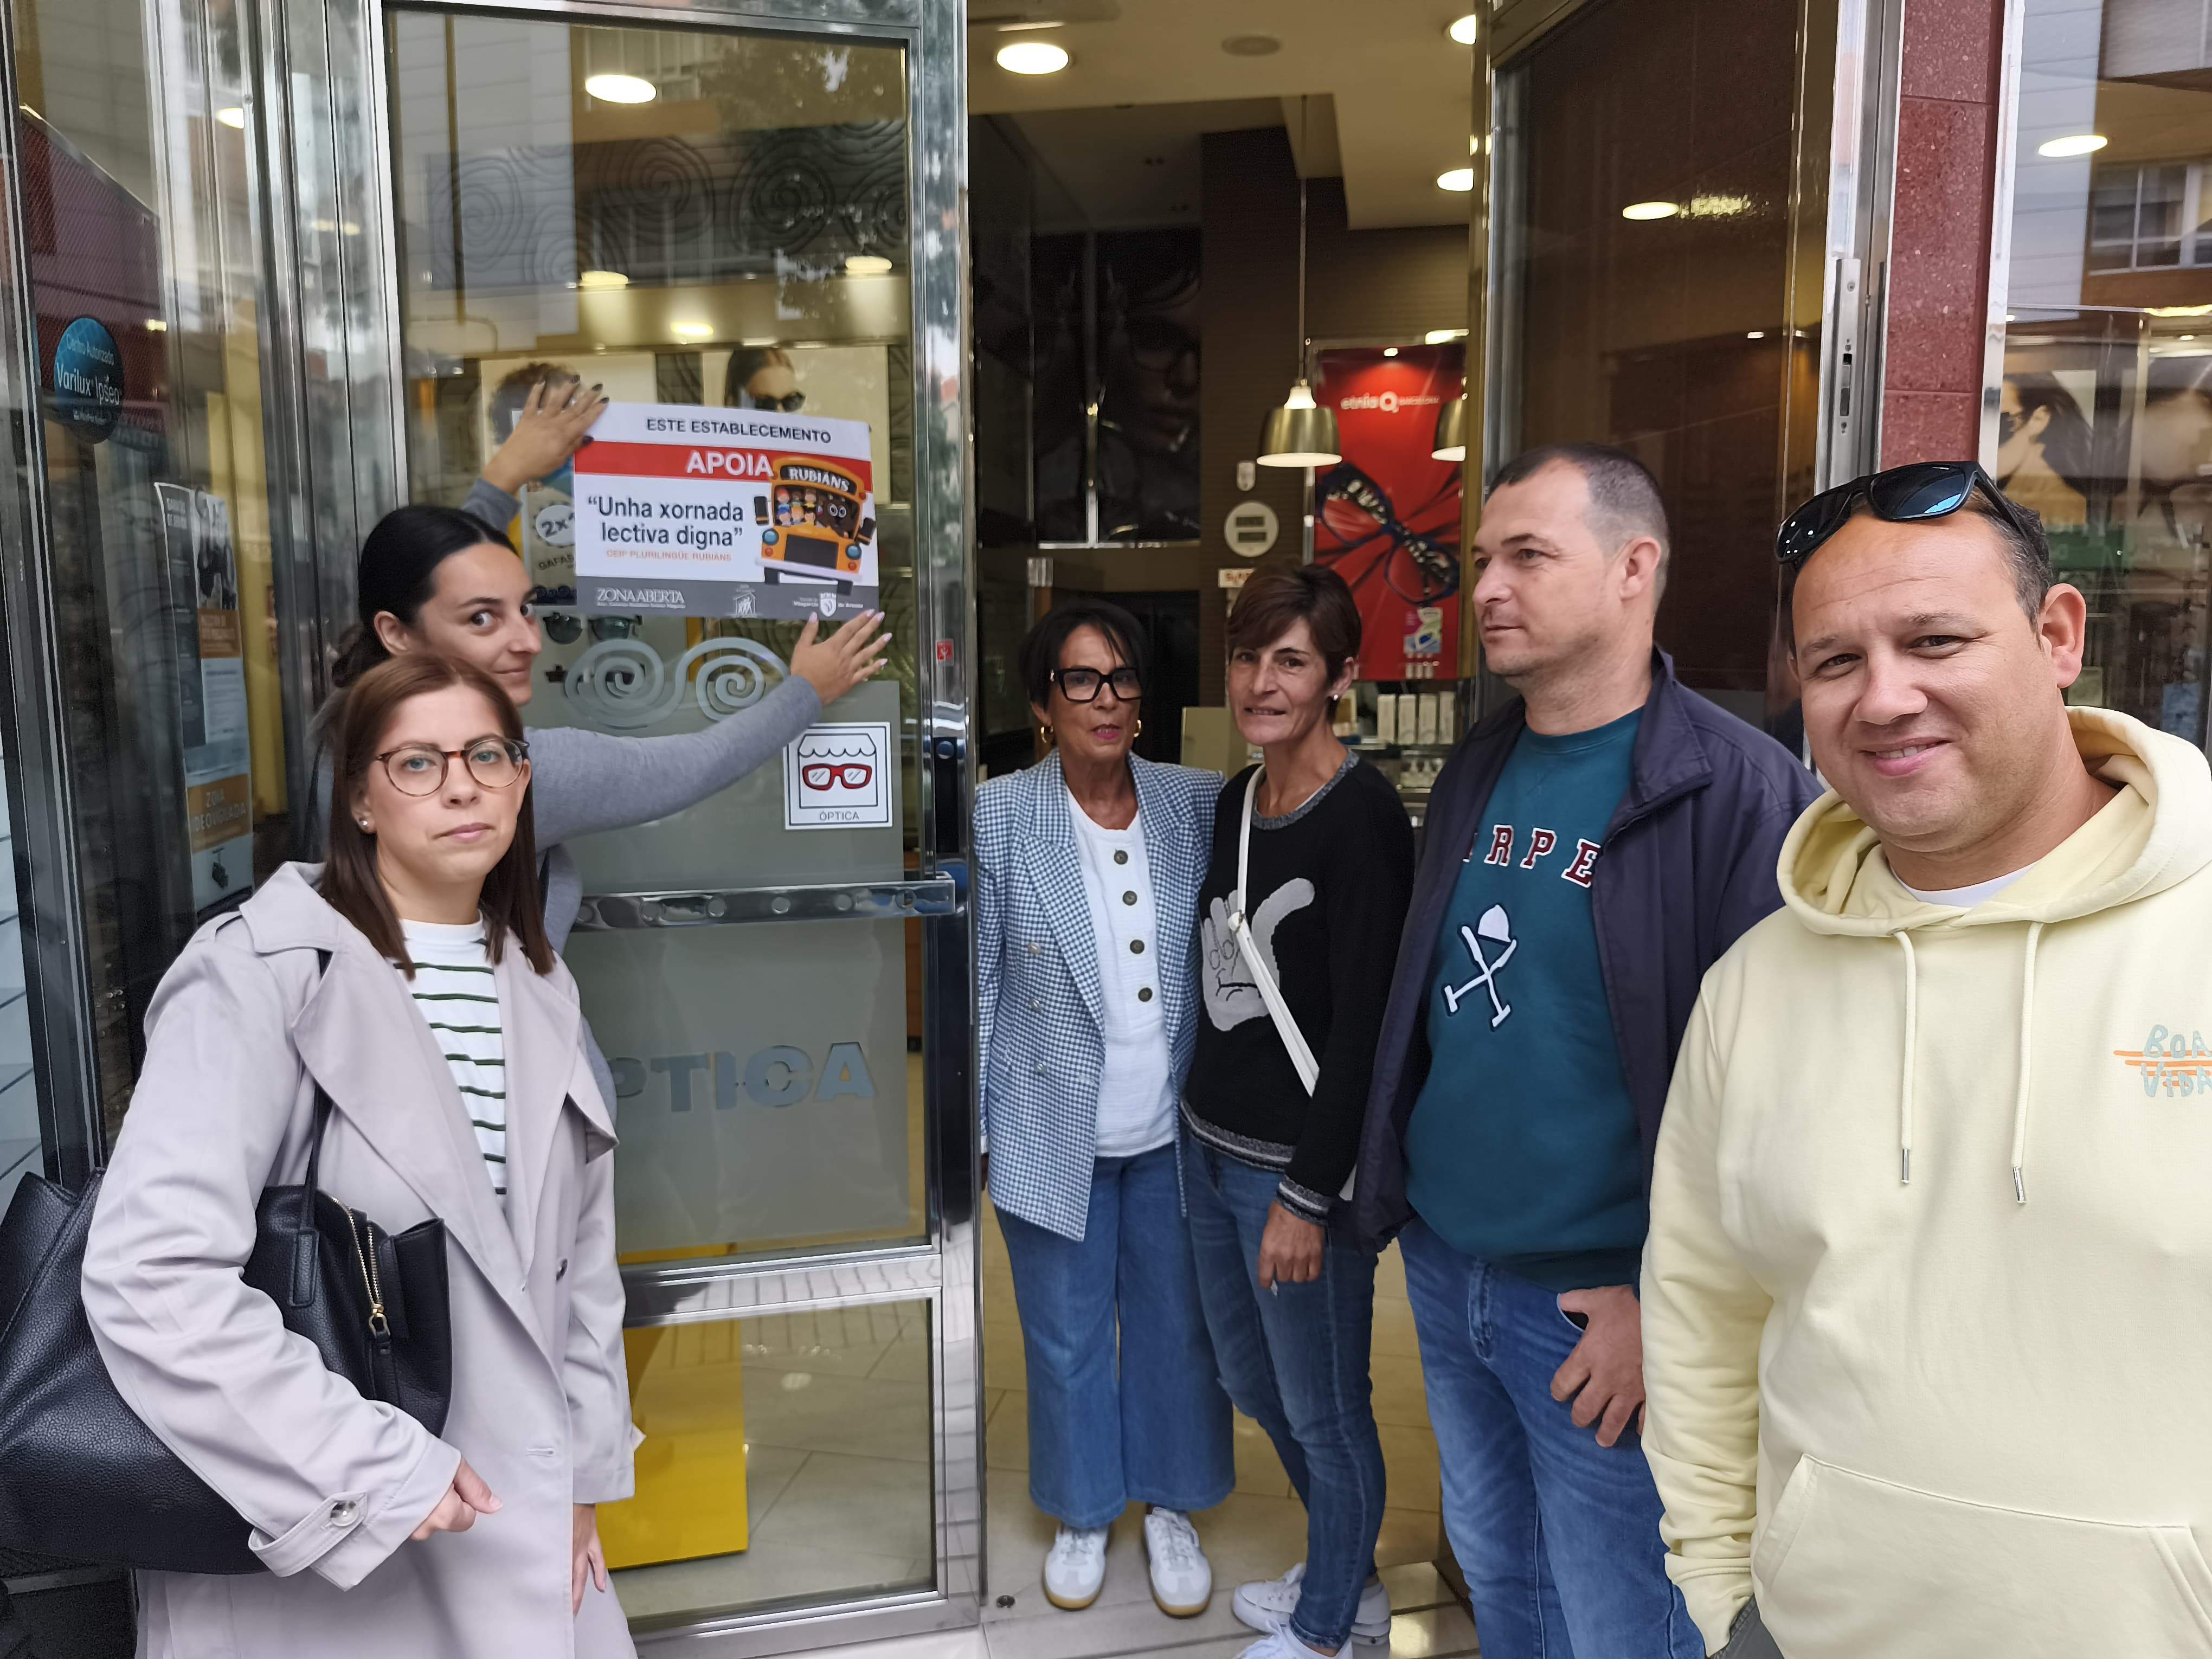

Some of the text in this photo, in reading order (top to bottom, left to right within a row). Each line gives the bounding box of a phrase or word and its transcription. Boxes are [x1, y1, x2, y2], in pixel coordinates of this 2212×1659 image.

[56, 362, 120, 406] Varilux Ipseo
[647, 418, 832, 443] ESTE ESTABLECEMENTO
[686, 449, 774, 477] APOIA
[659, 501, 744, 522] xornada
[601, 522, 670, 544] lectiva
[538, 554, 575, 570] GAFAS
[606, 549, 627, 558] CEIP
[819, 809, 860, 821] ÓPTICA
[2143, 1024, 2212, 1058] BOA
[2140, 1061, 2212, 1098] VIDA
